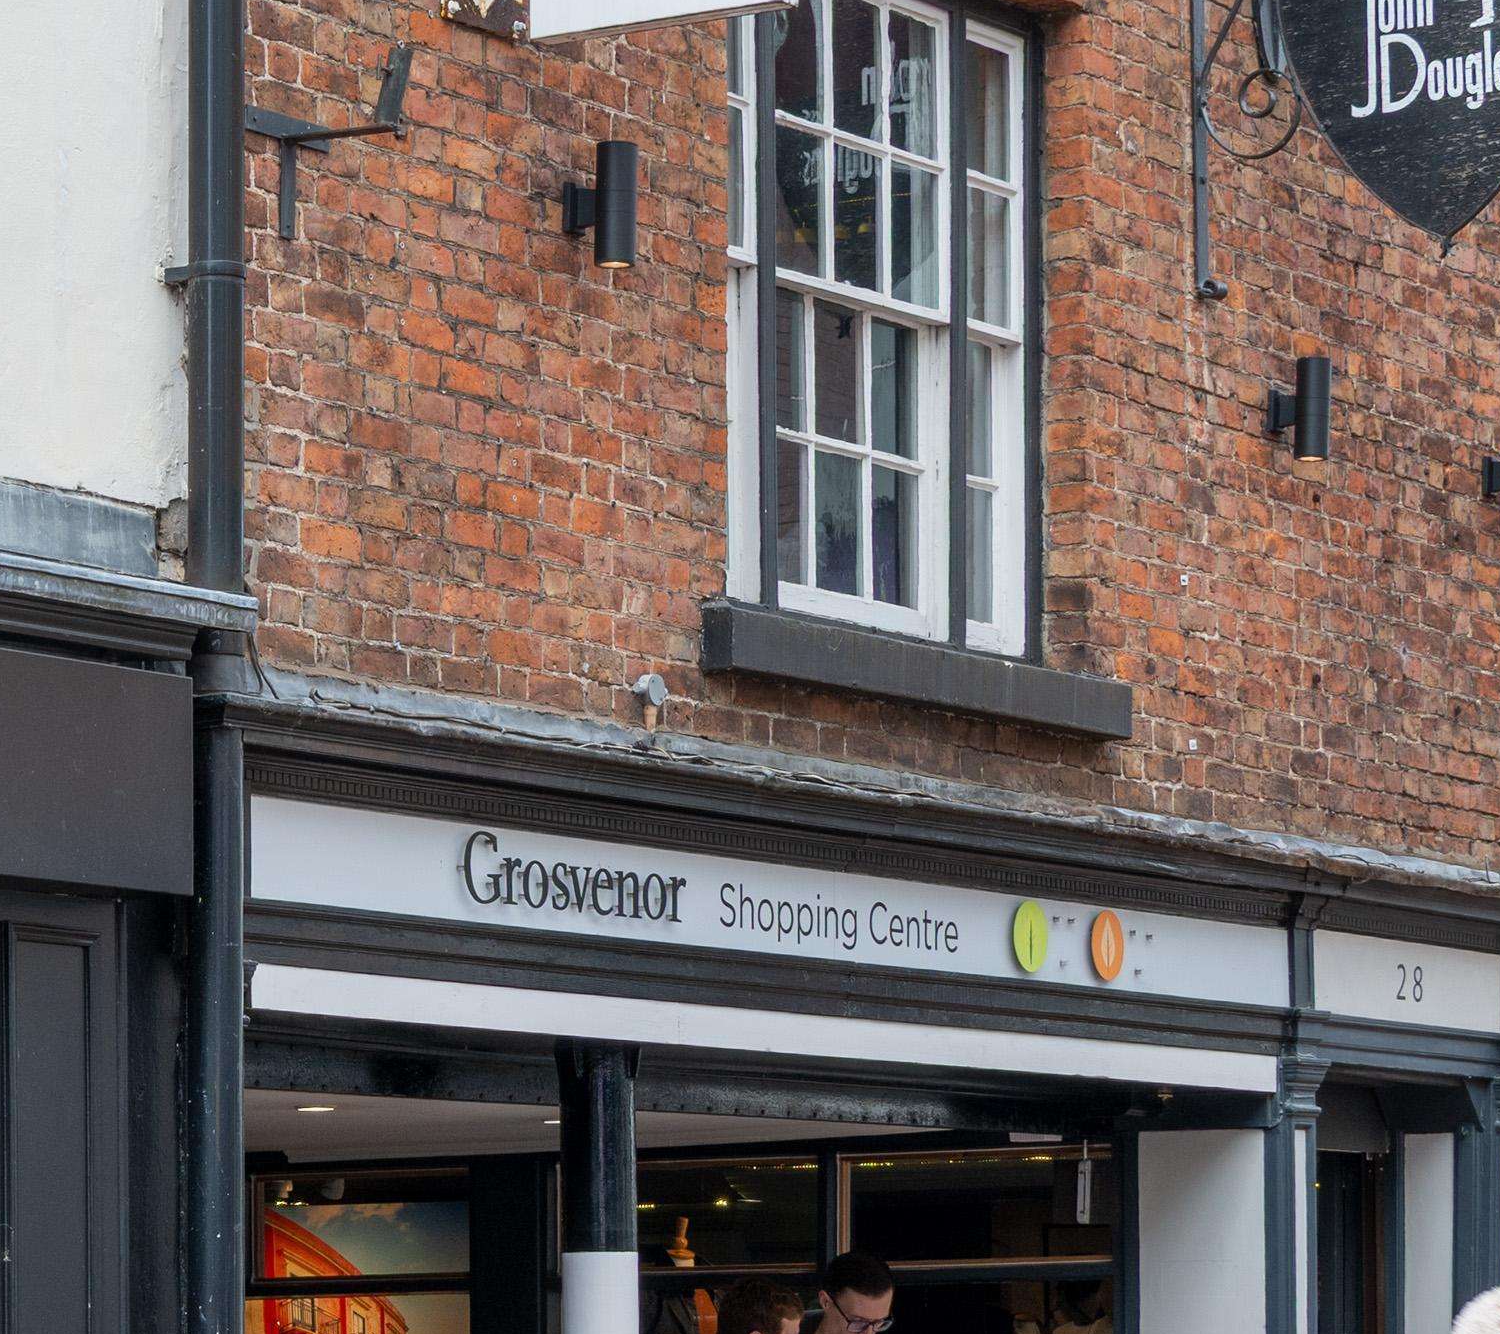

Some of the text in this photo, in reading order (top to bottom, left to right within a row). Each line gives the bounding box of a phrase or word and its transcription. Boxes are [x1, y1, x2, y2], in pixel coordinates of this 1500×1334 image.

[462, 829, 688, 924] Grosvenor
[719, 882, 960, 955] Shopping Centre
[1396, 964, 1423, 1002] 28
